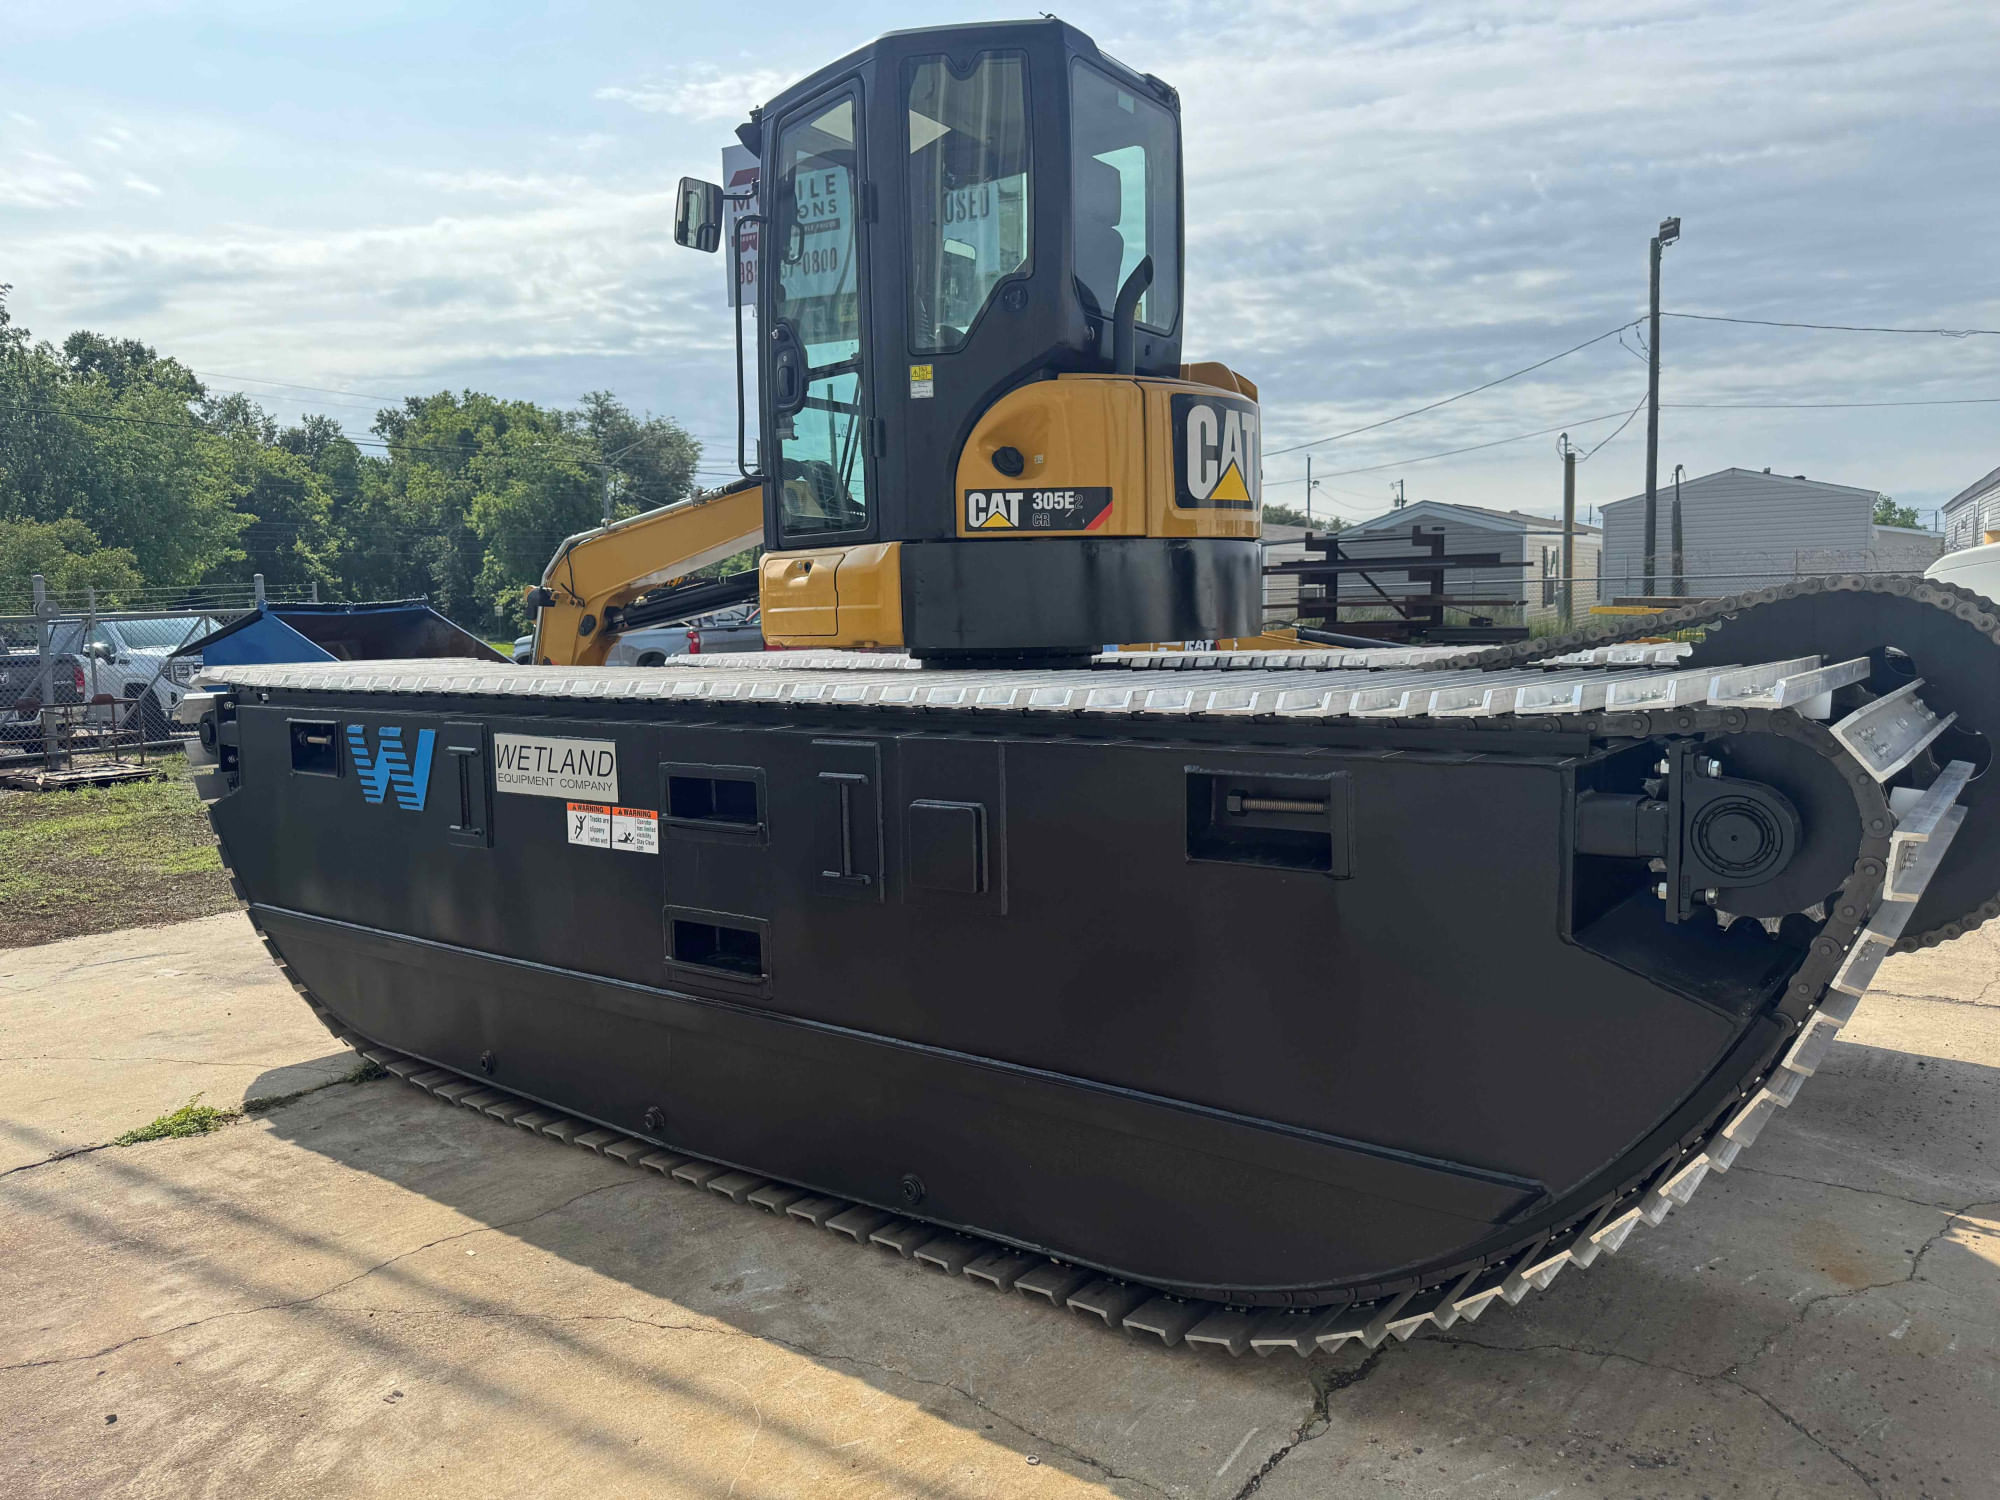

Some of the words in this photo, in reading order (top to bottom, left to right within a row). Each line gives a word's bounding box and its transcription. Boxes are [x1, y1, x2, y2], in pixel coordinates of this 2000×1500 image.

[1187, 404, 1255, 502] CAT
[968, 492, 1024, 528] CAT
[1032, 513, 1050, 527] CR
[496, 743, 614, 778] WETLAND
[497, 772, 554, 787] EQUIPMENT
[559, 778, 613, 792] COMPANY
[577, 803, 604, 813] WARNING
[623, 808, 651, 818] WARNING
